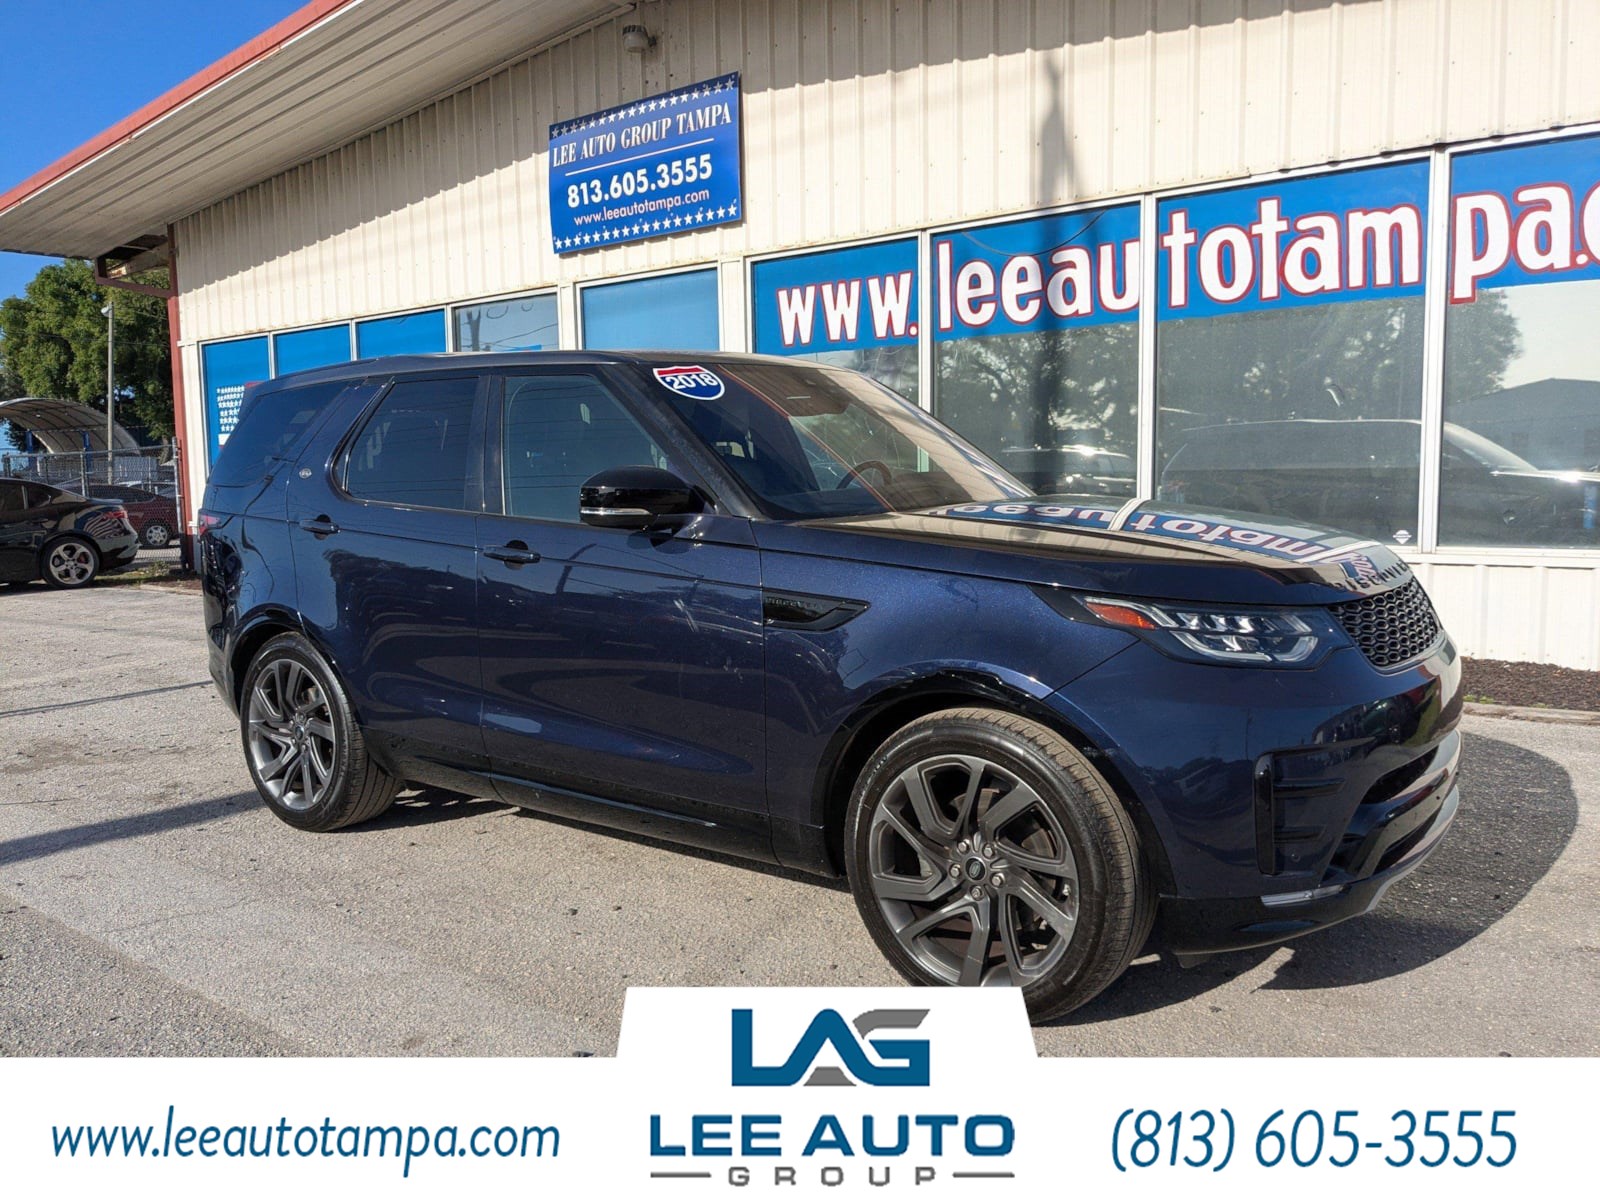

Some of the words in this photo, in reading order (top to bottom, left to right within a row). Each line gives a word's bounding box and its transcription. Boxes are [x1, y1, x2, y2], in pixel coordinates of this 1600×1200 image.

[553, 142, 576, 167] LEE
[580, 132, 615, 160] AUTO
[621, 117, 671, 148] GROUP
[677, 102, 731, 135] TAMPA
[567, 153, 712, 208] 813.605.3555
[574, 189, 709, 225] www.leeautotampa.com
[665, 373, 718, 389] 2018
